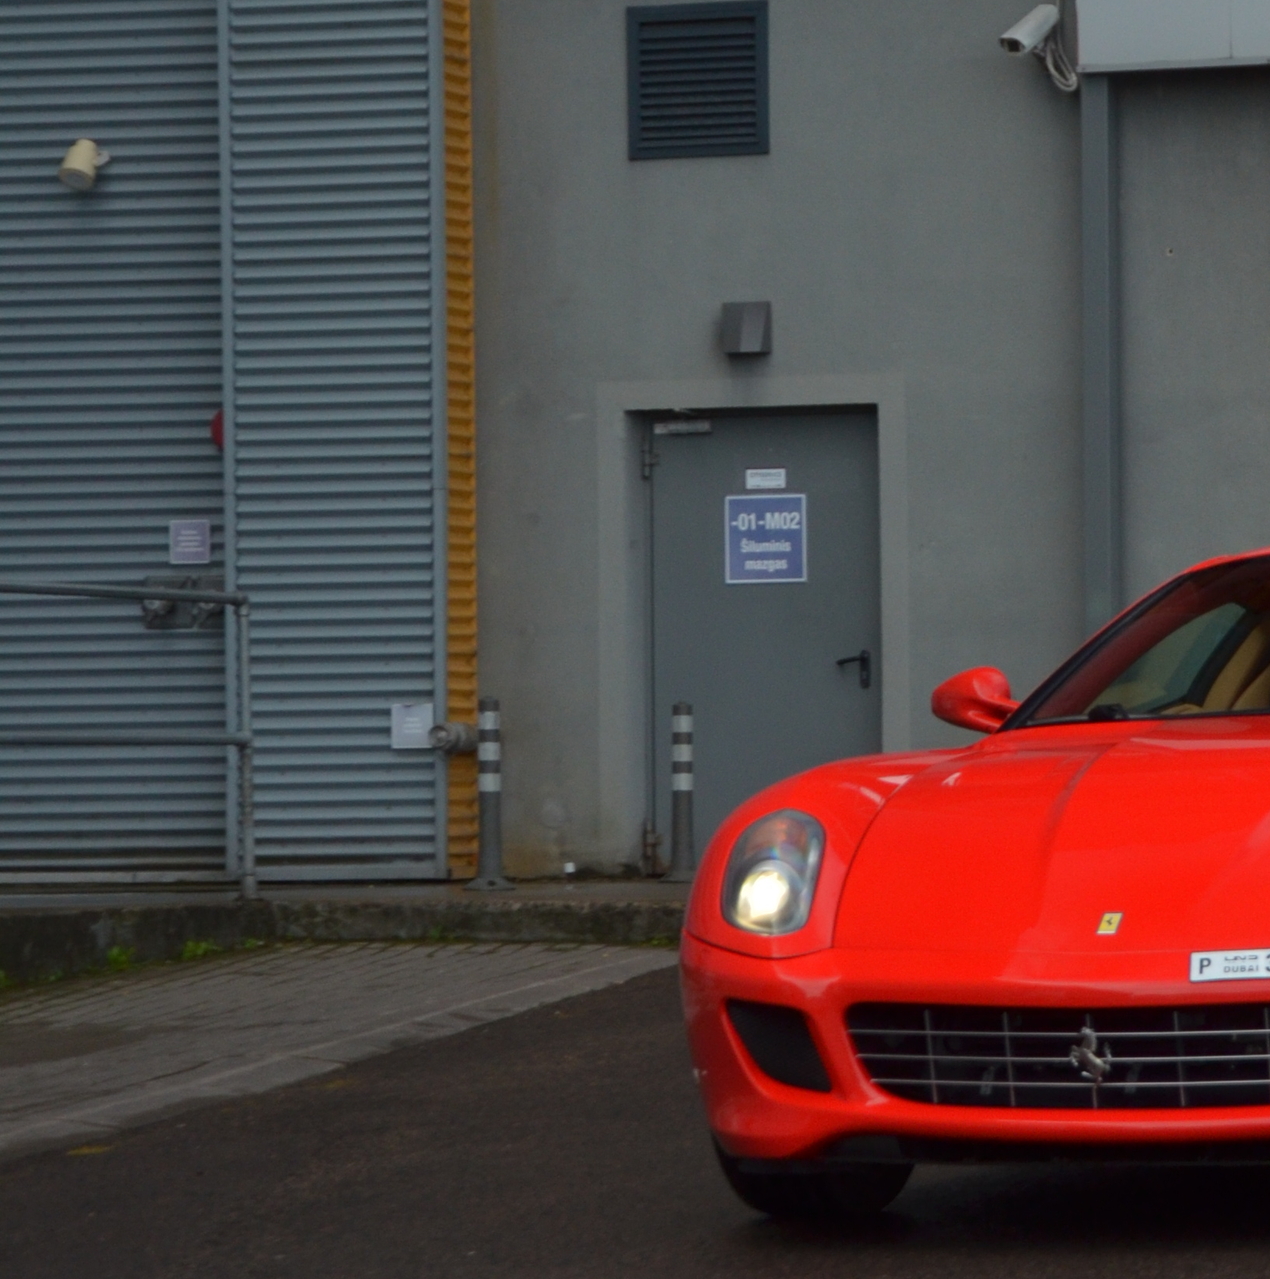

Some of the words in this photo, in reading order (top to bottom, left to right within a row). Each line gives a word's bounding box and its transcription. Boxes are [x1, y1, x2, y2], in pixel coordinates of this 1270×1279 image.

[731, 512, 801, 531] -01-M02
[744, 559, 788, 572] mazgas
[1199, 957, 1211, 974] P
[1223, 964, 1259, 973] DUBAI
